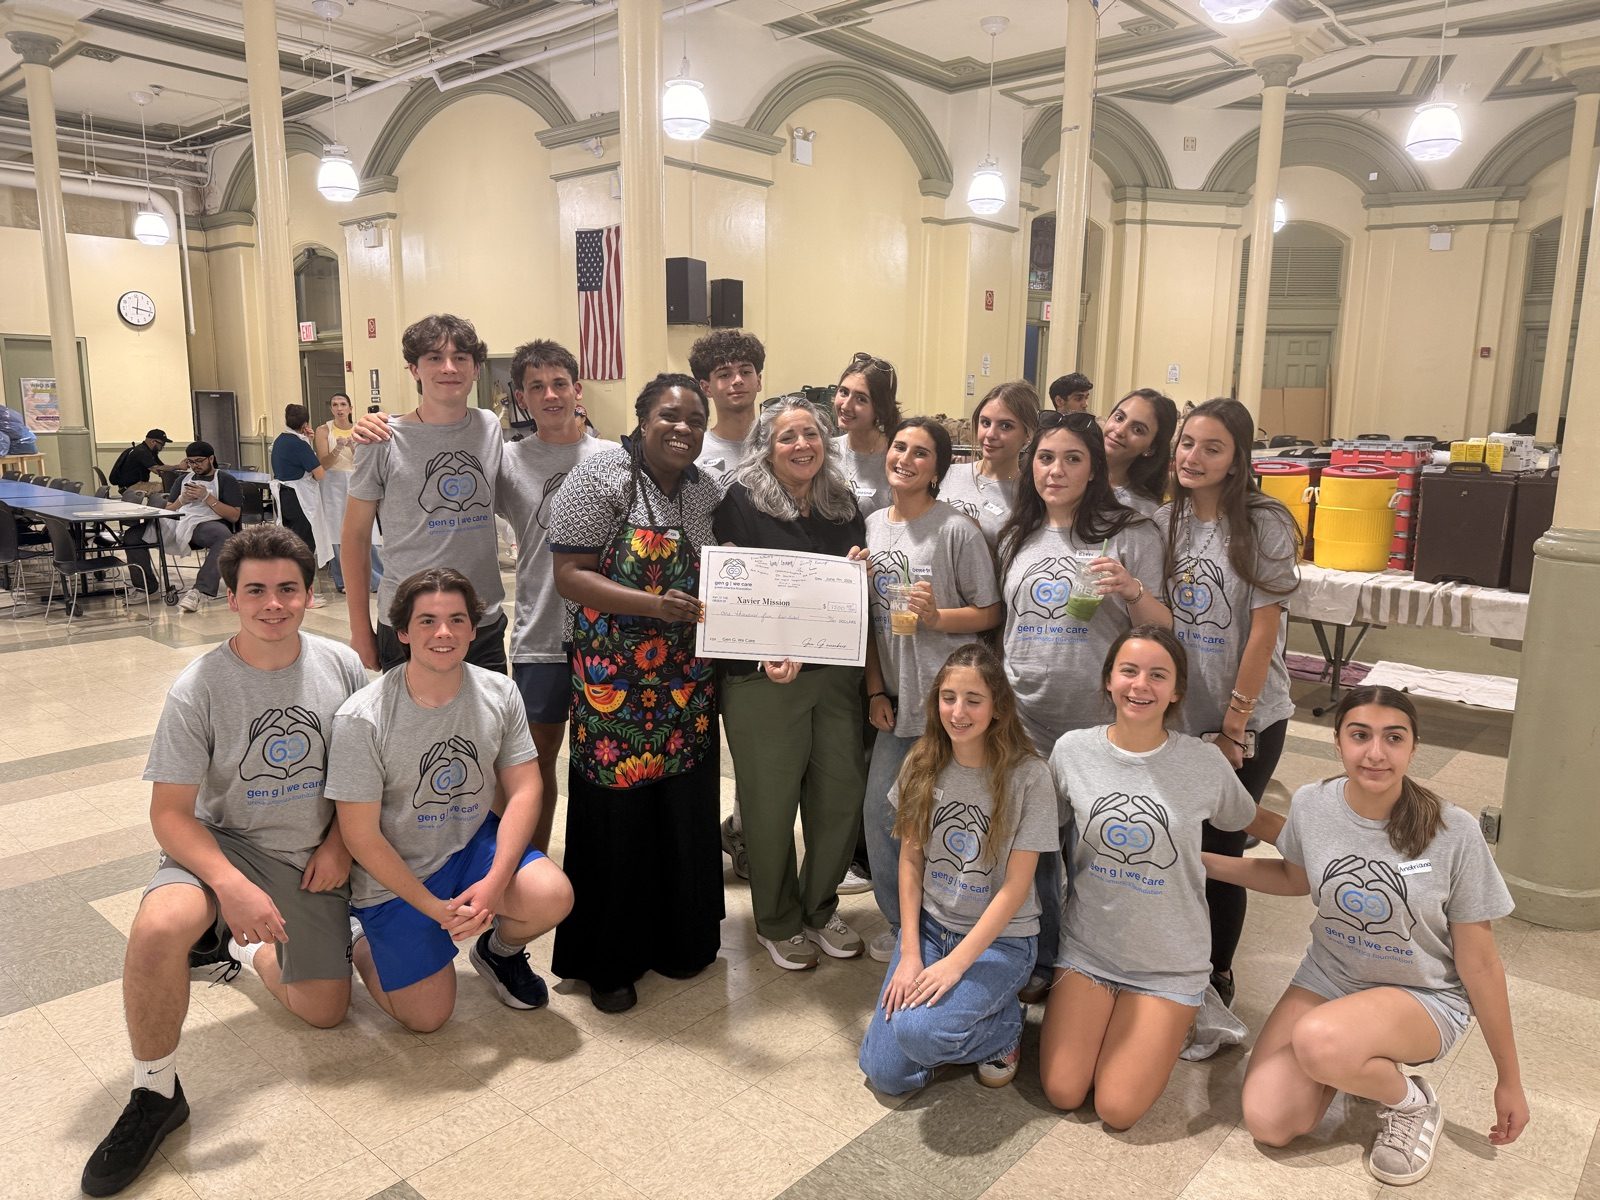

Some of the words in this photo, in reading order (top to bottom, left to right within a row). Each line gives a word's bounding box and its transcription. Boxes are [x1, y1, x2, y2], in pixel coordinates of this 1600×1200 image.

[428, 520, 446, 528] gen
[762, 598, 790, 606] Mission
[1018, 625, 1034, 634] gen
[1037, 626, 1042, 634] g
[1178, 631, 1184, 640] g
[1203, 636, 1225, 645] care
[247, 790, 268, 798] gen
[272, 789, 278, 797] g
[287, 784, 300, 792] we
[417, 814, 437, 822] gen
[440, 812, 445, 821] g
[461, 803, 479, 813] care
[931, 870, 948, 881] gen
[949, 875, 954, 884] g
[1110, 869, 1116, 877] g
[1125, 872, 1140, 880] we
[1142, 876, 1165, 886] care
[1325, 926, 1345, 939] gen
[1348, 935, 1356, 944] g
[1364, 940, 1382, 950] we
[1385, 945, 1413, 956] care
